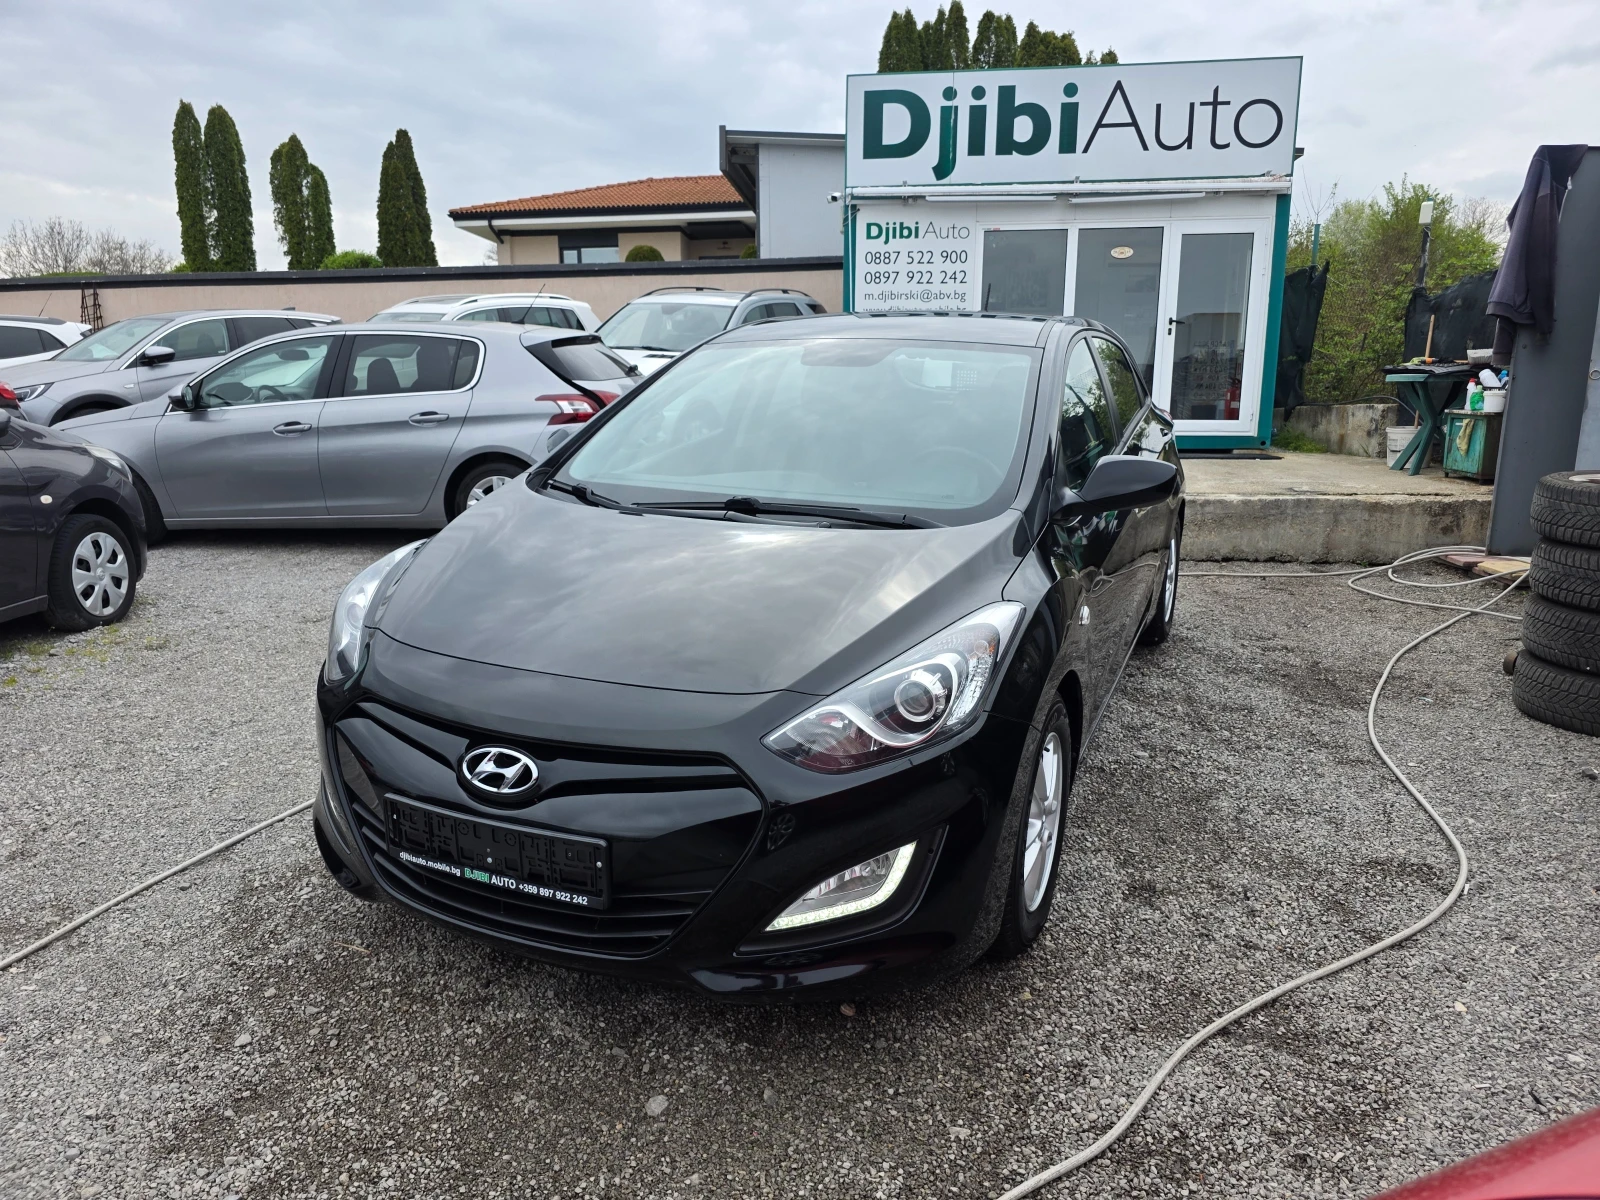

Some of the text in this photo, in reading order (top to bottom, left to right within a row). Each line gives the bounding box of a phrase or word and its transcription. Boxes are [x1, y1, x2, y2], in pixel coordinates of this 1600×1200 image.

[864, 250, 968, 265] 0887 522 900
[864, 270, 968, 285] 0897 922 242
[864, 289, 967, 303] m.djibirski@abv.bg
[399, 851, 588, 905] djibiauto.mobile.bg DJIBI AUTO +359 897 922 242
